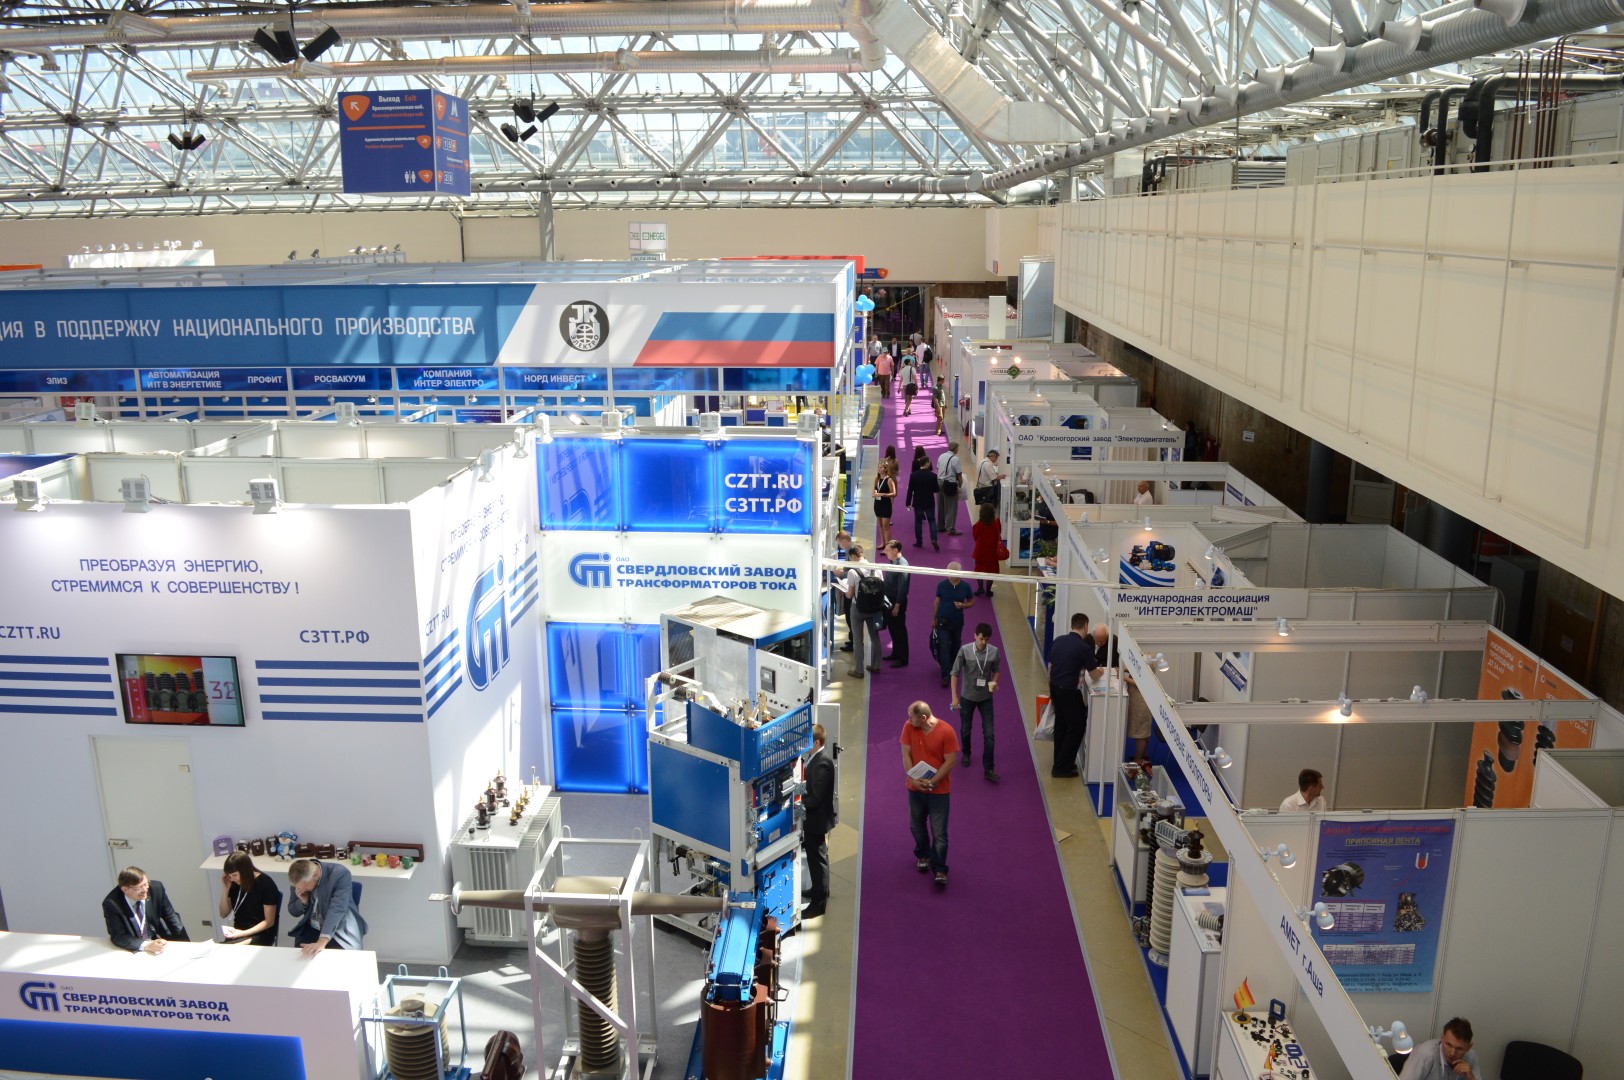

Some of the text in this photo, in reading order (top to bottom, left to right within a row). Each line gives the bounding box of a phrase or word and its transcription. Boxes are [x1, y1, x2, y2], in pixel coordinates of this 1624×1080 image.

[378, 95, 400, 103] Выход
[34, 320, 46, 338] В
[57, 320, 161, 340] ПОДДЕРЖКУ
[173, 318, 322, 339] НАЦИОНАЛЬНОГО
[336, 316, 476, 338] ПРОИЗВОДСТВА
[571, 334, 600, 350] ЭЛЕКТРО
[46, 377, 68, 385] ЭЛИЗ
[148, 371, 220, 380] АВТОМАТИЗАЦИЯ
[248, 376, 282, 384] ПРОФИТ
[314, 375, 366, 384] РОСВАКУУМ
[424, 370, 472, 378] КОМПАНИЯ
[524, 374, 586, 384] НОРД ИНВЕСТ
[170, 380, 222, 388] ЭНЕРГЕТИКЕ
[414, 379, 484, 388] ИНТЕР ЭЛЕКТРО
[724, 473, 802, 489] CZTT.RU
[725, 498, 802, 513] СЗТТ.РФ
[80, 558, 263, 575] ПРЕОБРАЗУЯ ЭНЕРГИЮ,
[616, 564, 797, 580] СВЕРДЛОВСКИЙ ЗАВОД
[52, 580, 143, 593] СТРЕМИМСЯ
[151, 580, 160, 593] К
[168, 580, 290, 595] СОВЕРШЕНСТВУ
[617, 578, 797, 590] ТРАНСФОРМАТОРОВ ТОКА
[1118, 593, 1270, 604] Международная ассоциация
[1134, 606, 1258, 616] "ИНТЕРЭЛЕКТРОМАШ"
[299, 630, 370, 644] СЗТТ.РФ
[1186, 751, 1212, 805] ИЗОЛЯТОРЫ
[1281, 915, 1300, 955] АМЕТ
[1302, 954, 1323, 998] г.Аша
[63, 993, 229, 1012] СВЕРДЛОВСКИЙ ЗАВОД
[65, 1004, 230, 1022] ТРАНСФОРМАТОРОВ ТОКА
